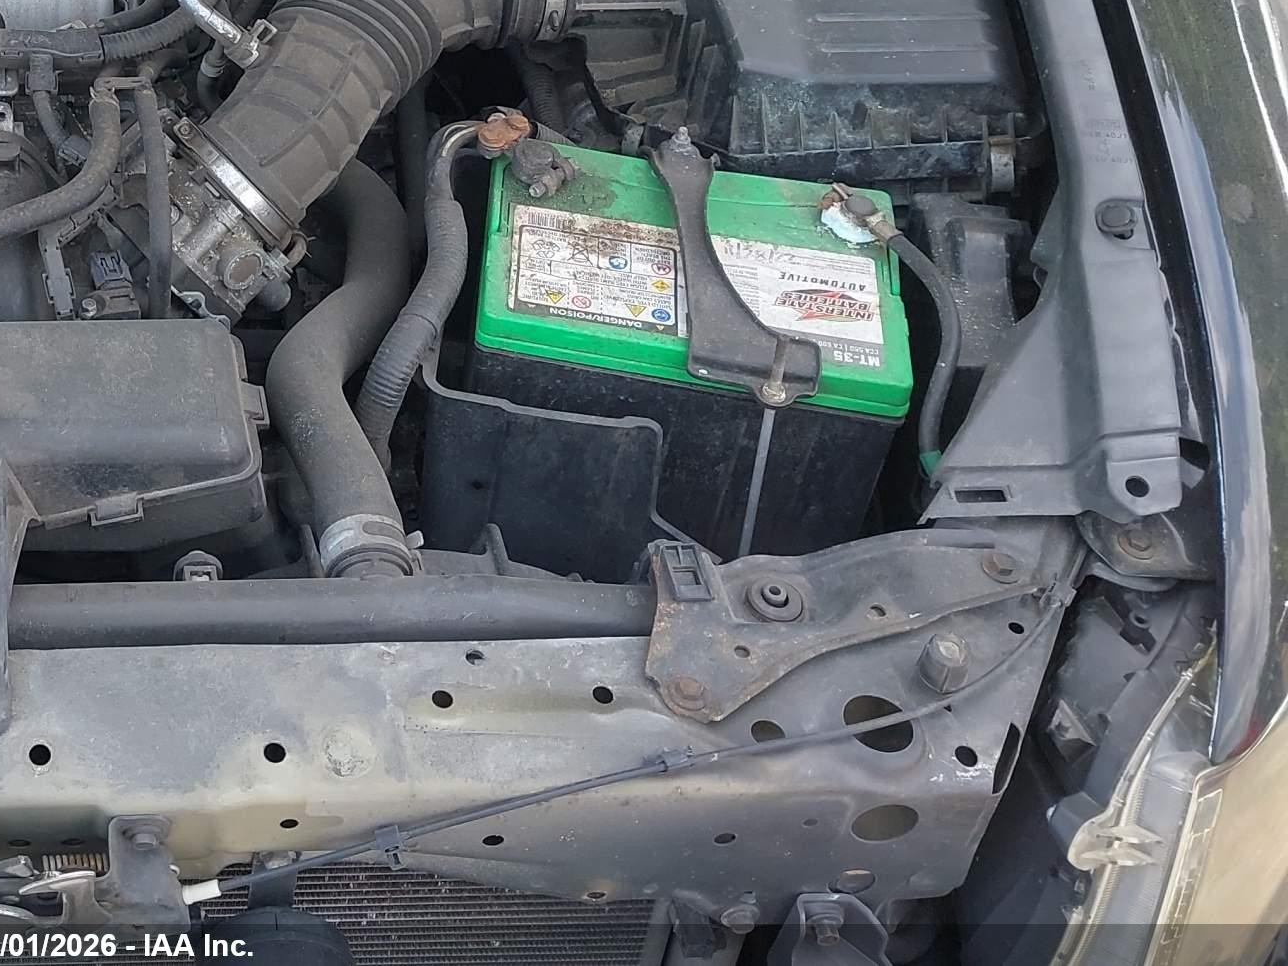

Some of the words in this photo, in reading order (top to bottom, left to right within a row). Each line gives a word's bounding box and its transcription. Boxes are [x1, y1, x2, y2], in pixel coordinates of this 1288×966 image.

[778, 271, 867, 292] AUTOMOTIVE
[775, 297, 874, 321] INTERSTATE
[781, 291, 871, 312] BATTERIES
[549, 307, 643, 328] DANGER/POISON
[833, 350, 881, 367] MT-35
